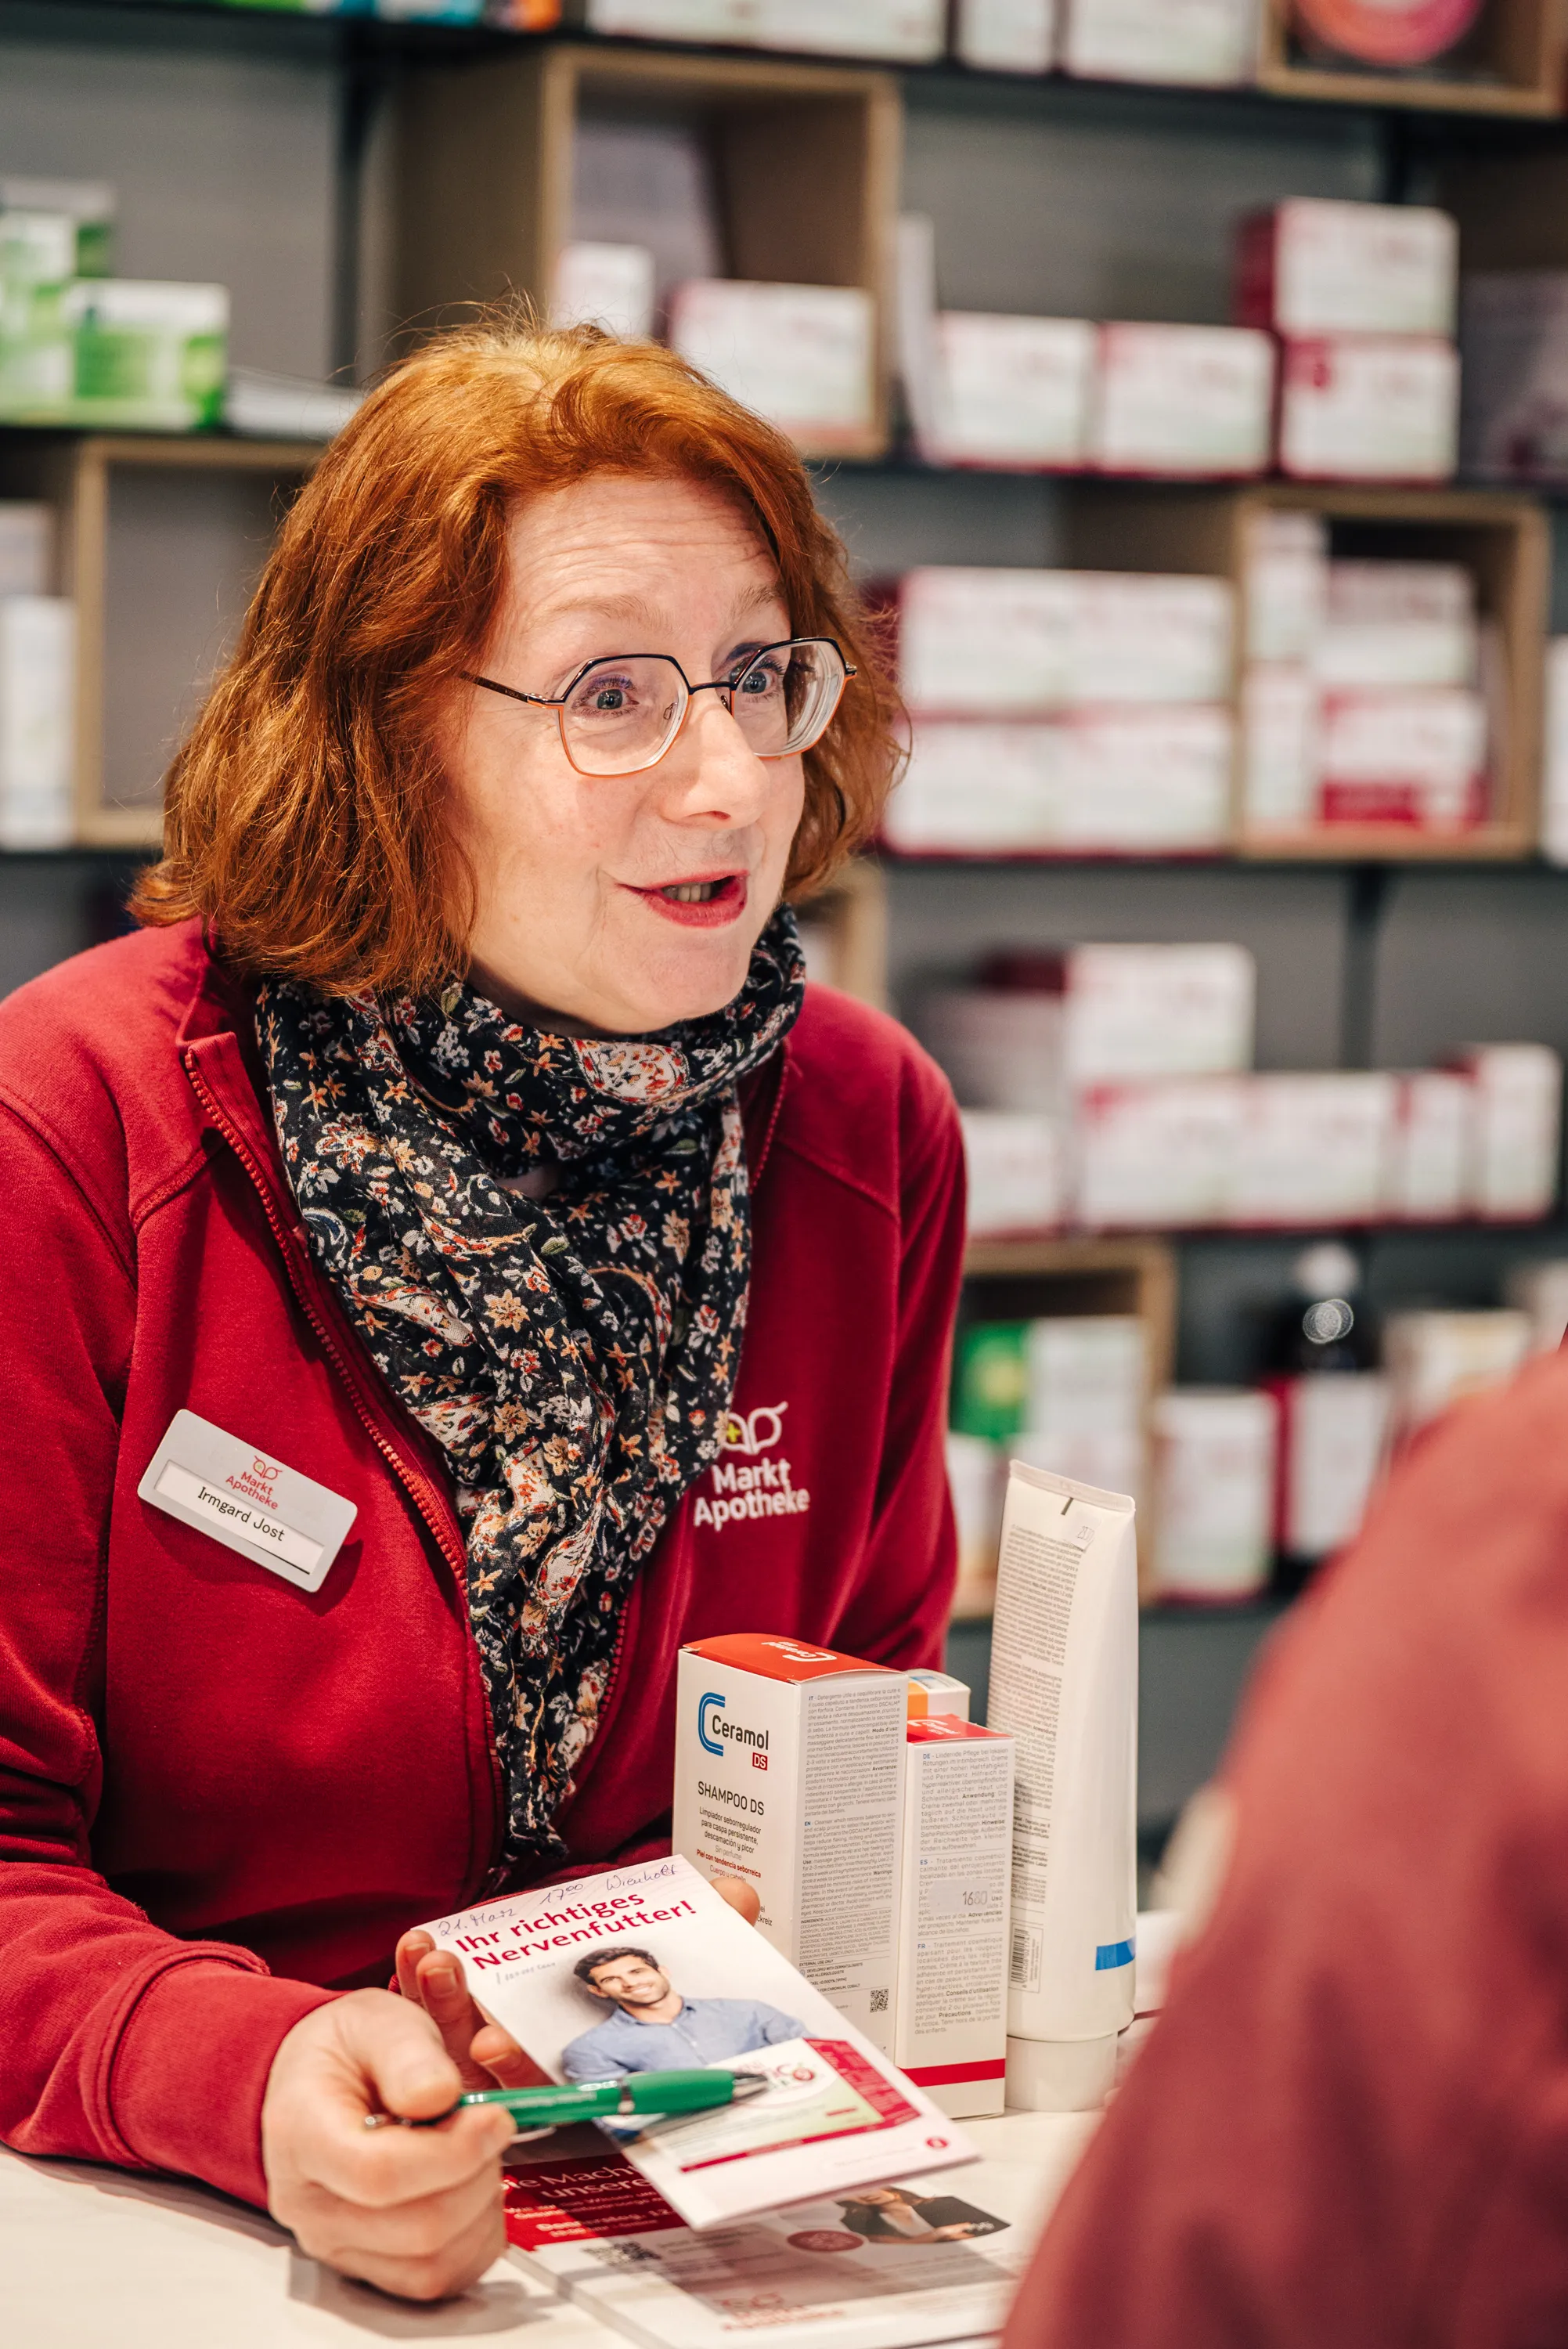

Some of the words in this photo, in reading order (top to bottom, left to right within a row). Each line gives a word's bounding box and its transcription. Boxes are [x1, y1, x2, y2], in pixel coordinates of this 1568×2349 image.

[241, 1470, 273, 1496] Markt
[712, 1457, 791, 1494] Markt
[225, 1475, 278, 1510] Apotheke
[694, 1484, 810, 1532] Apotheke
[197, 1486, 251, 1523] Irmgard
[254, 1517, 285, 1542] Jost
[712, 1715, 769, 1750] Ceramol
[754, 1755, 766, 1769] DS
[697, 1781, 747, 1810] SHAMPOO
[750, 1799, 764, 1816] DS
[700, 1806, 723, 1821] Limpiador
[723, 1816, 761, 1835] seborregulador
[701, 1818, 712, 1829] para
[712, 1823, 727, 1834] caspa
[728, 1828, 759, 1845] persistente,
[705, 1831, 736, 1848] descamación
[741, 1842, 755, 1853] picor
[723, 1848, 742, 1860] perfume
[709, 1865, 725, 1877] Cuerpo
[714, 1855, 736, 1870] tendencia
[737, 1864, 761, 1878] seborreica
[456, 1932, 500, 1953] Ihr
[510, 1893, 644, 1937] richtiges
[473, 1900, 697, 1970] Nervenfutter!
